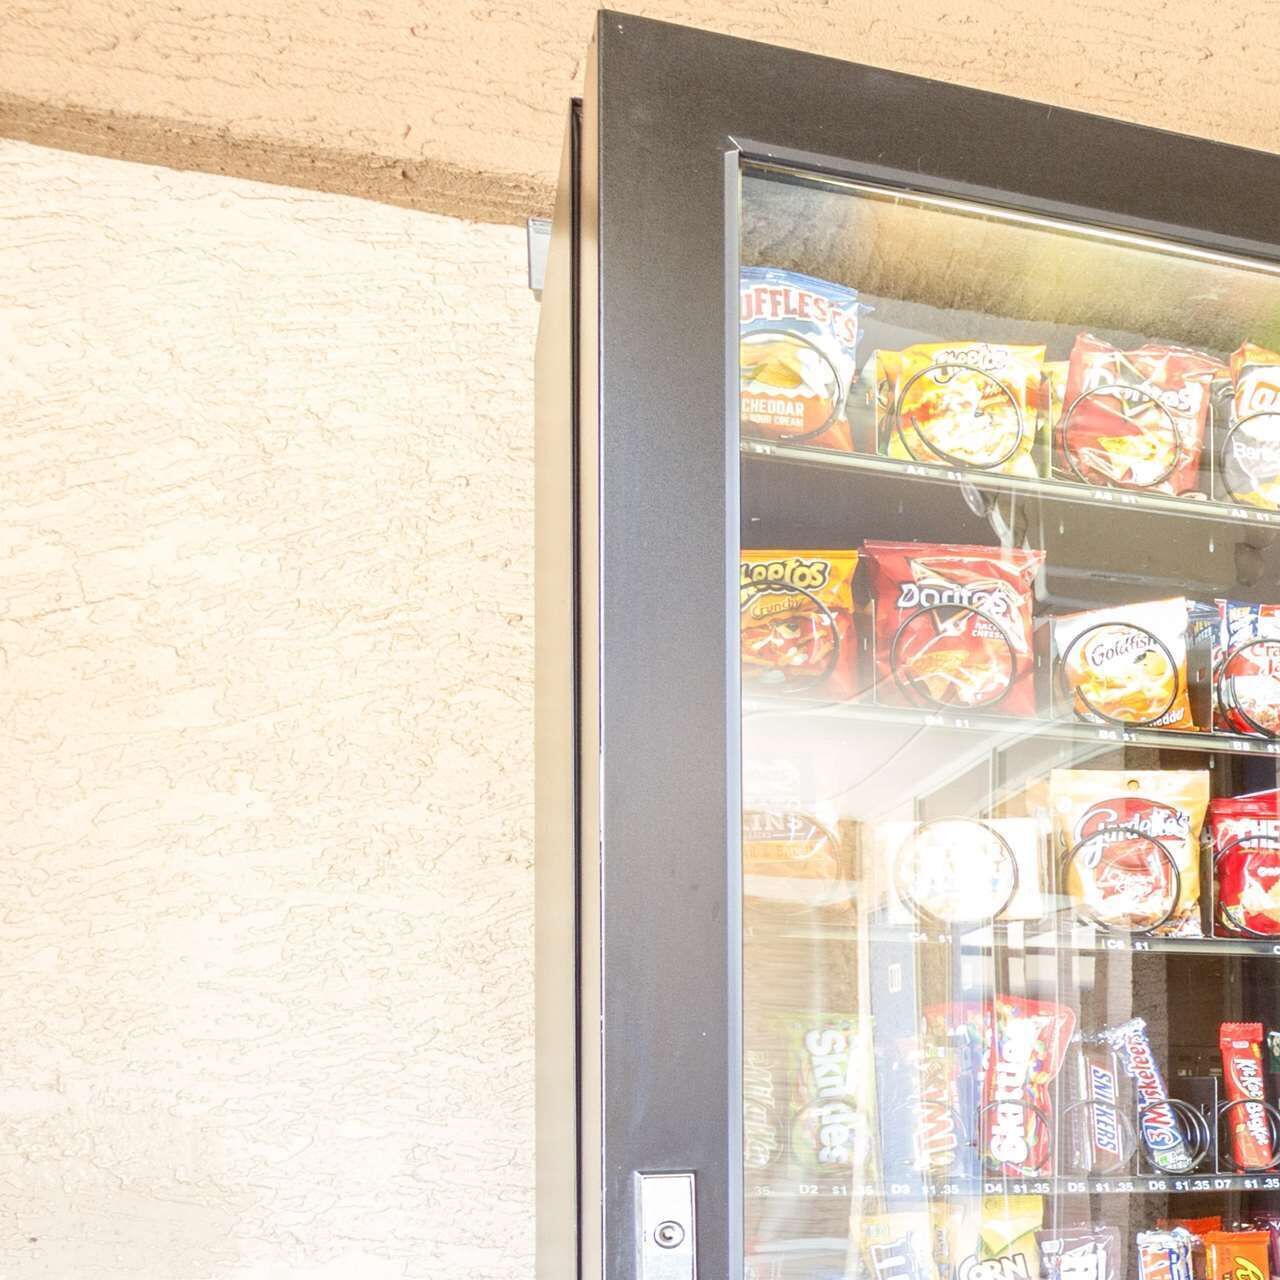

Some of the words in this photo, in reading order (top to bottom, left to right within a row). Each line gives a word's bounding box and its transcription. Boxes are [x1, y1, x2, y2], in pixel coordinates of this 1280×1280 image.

[897, 583, 1010, 616] Doritos
[1091, 1064, 1119, 1155] SNIKERS
[799, 1184, 819, 1194] D2
[985, 1183, 1002, 1193] D4
[1068, 1182, 1086, 1192] D5
[1149, 1181, 1166, 1191] D6
[1214, 1179, 1231, 1189] D7
